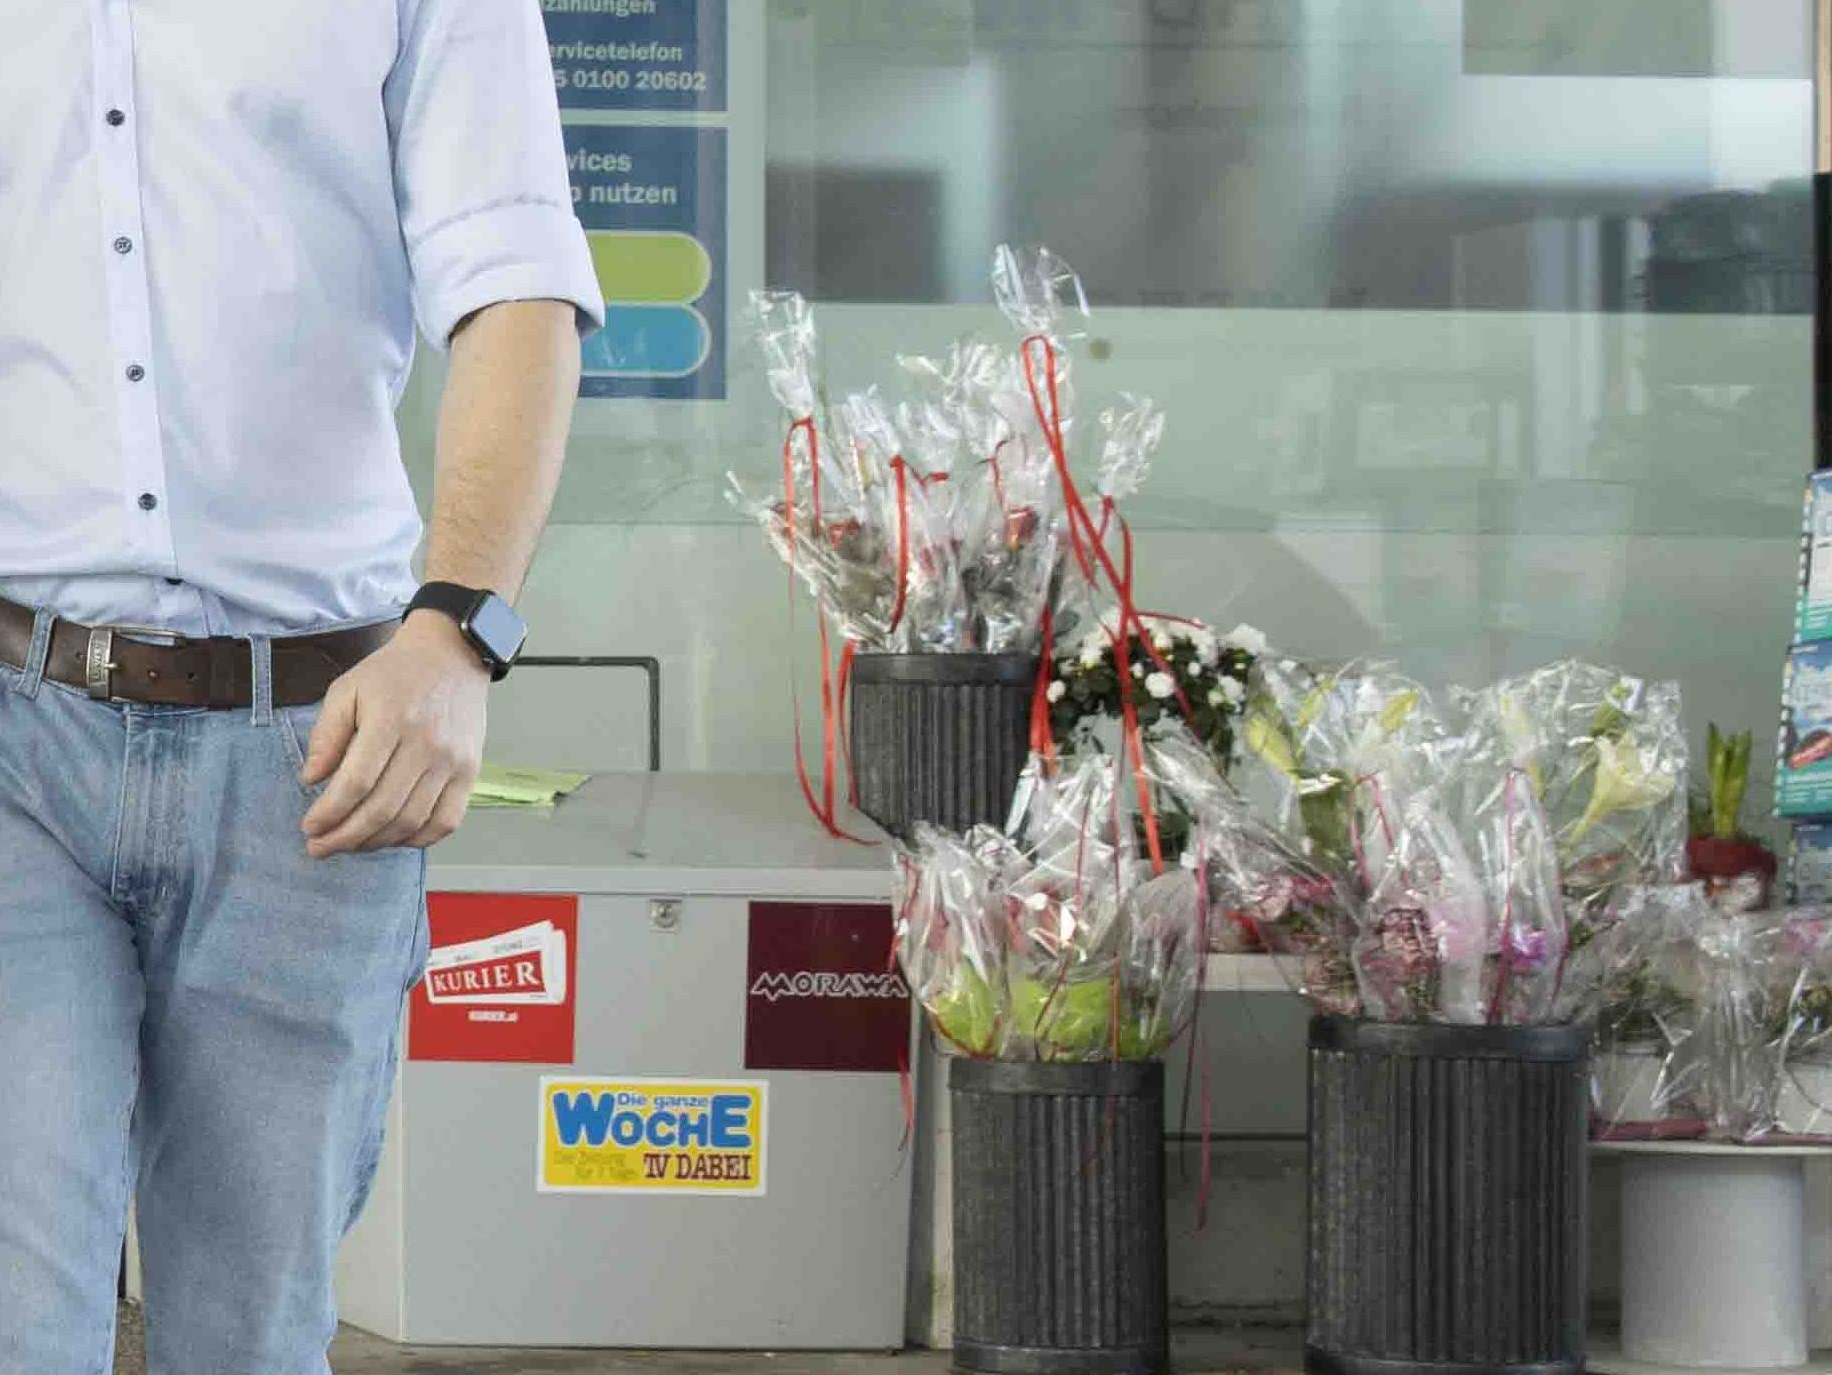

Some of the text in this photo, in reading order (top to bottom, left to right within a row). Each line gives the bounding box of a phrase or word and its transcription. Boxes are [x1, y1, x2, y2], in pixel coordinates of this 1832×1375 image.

[573, 71, 630, 89] 0100
[635, 71, 707, 91] 20602
[589, 183, 678, 205] nutzen
[434, 961, 540, 993] KURIER
[750, 971, 911, 1003] MORAWA
[616, 1092, 711, 1110] Die ganze
[643, 1153, 673, 1180] TV
[674, 1153, 753, 1181] DABEI
